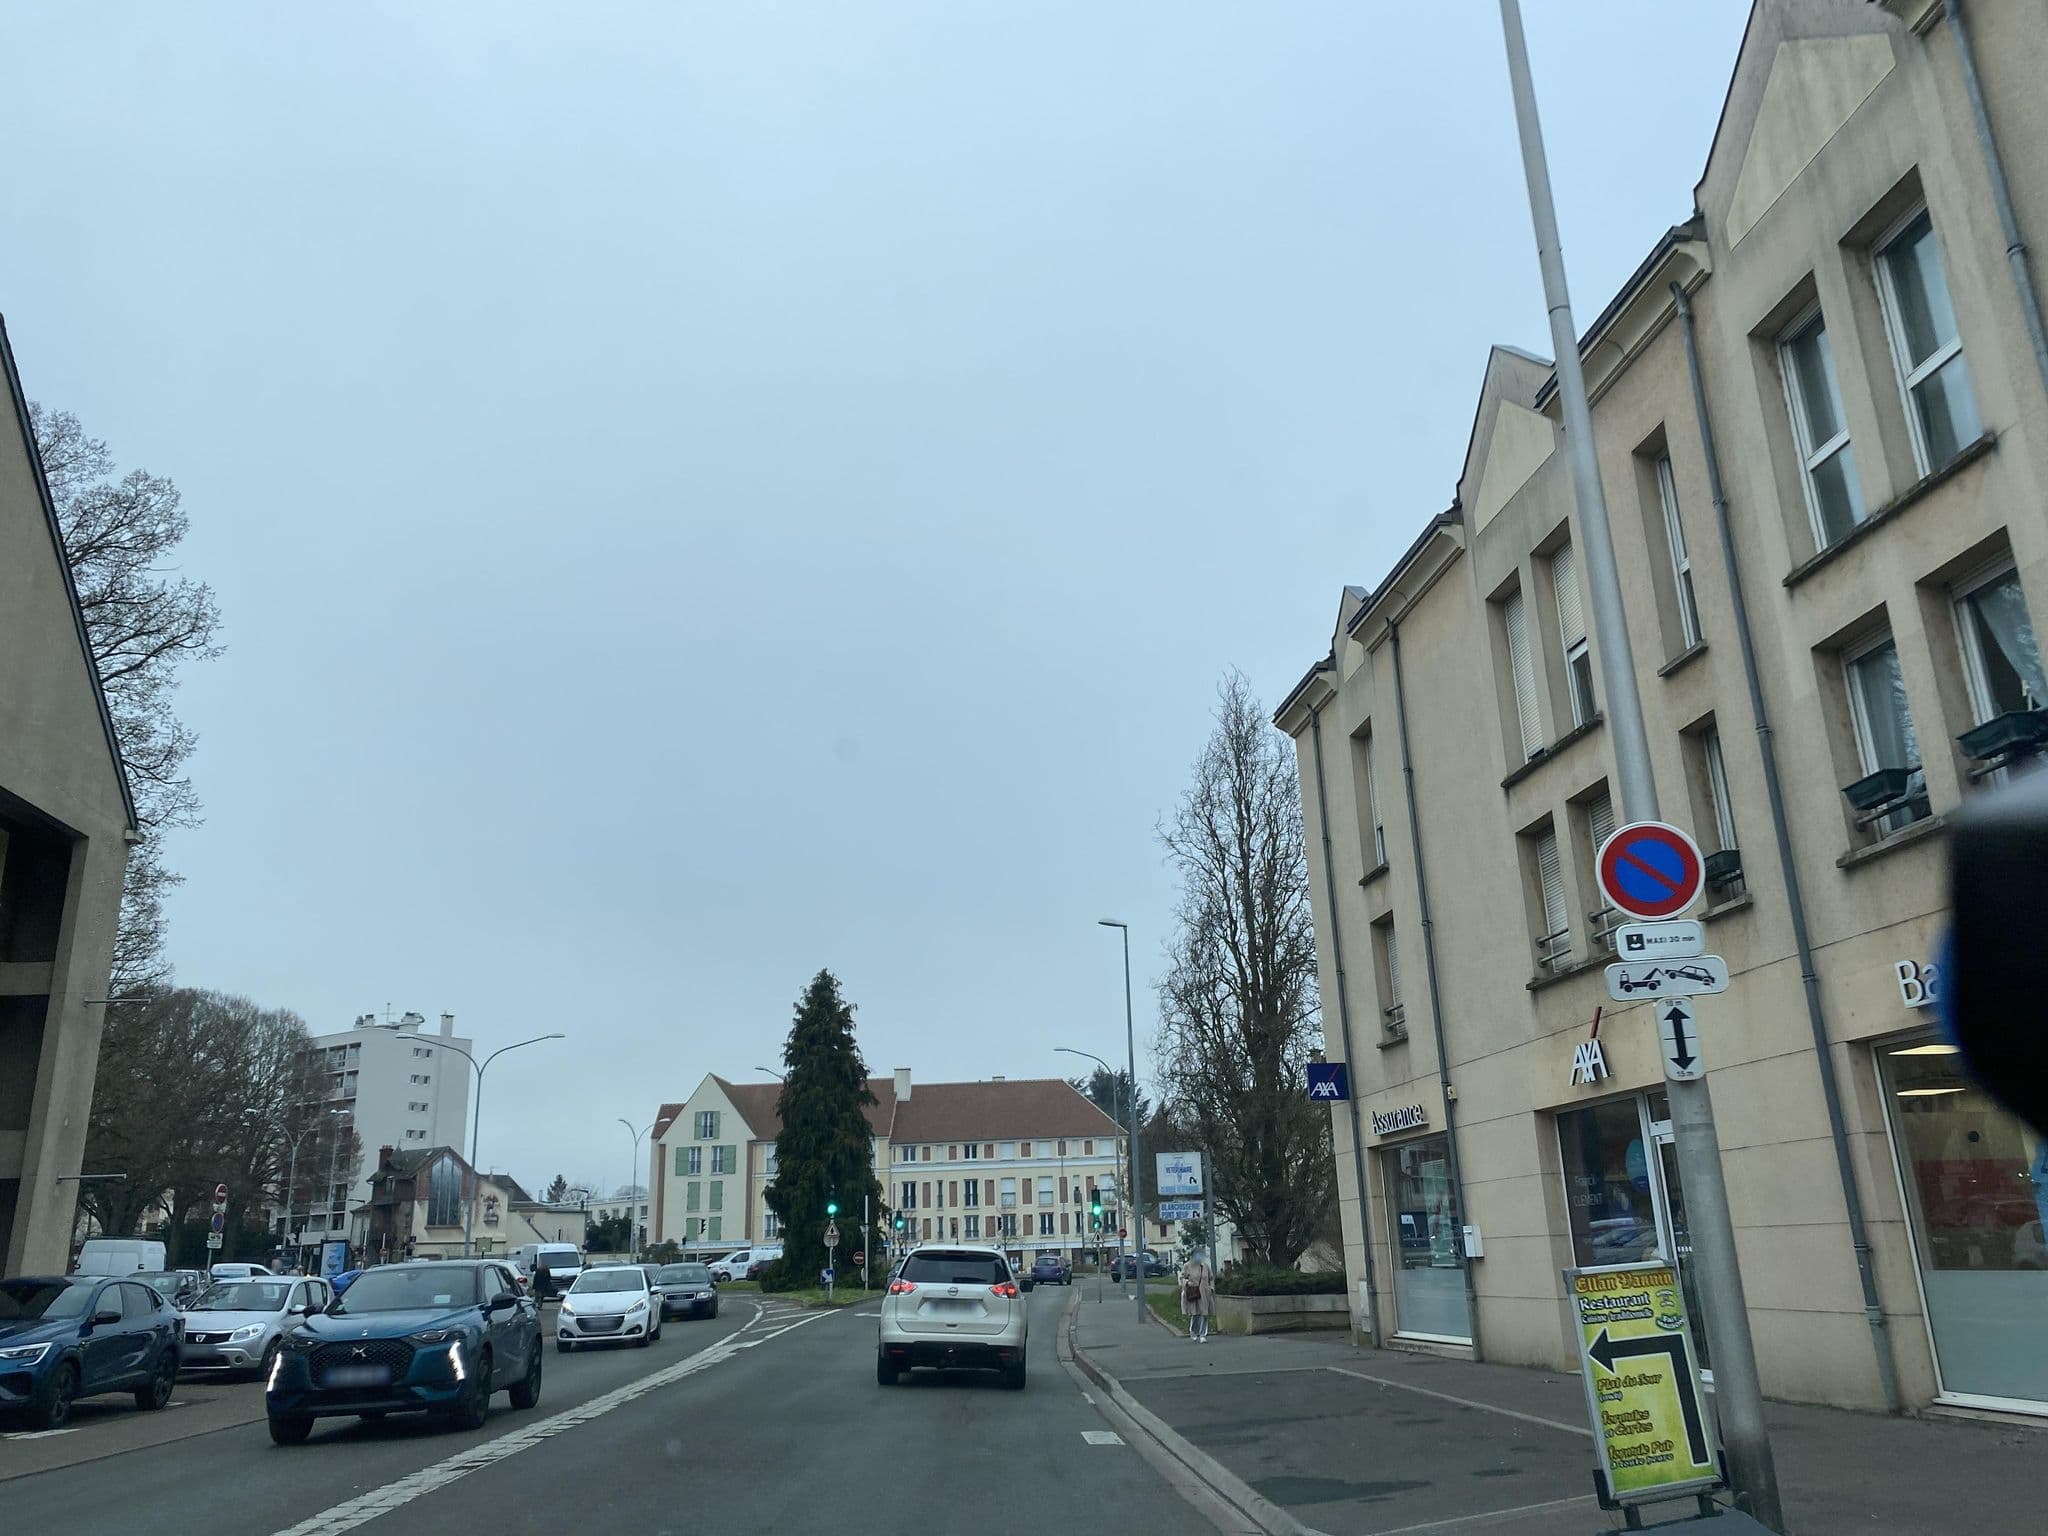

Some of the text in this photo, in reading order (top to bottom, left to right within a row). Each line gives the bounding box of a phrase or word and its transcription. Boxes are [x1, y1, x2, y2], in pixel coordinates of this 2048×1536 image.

[1570, 1039, 1612, 1086] AXA
[1310, 1081, 1339, 1097] AXA
[1371, 1104, 1424, 1135] Assurance
[1575, 1276, 1617, 1293] Ellan
[1579, 1293, 1650, 1311] Restaurant
[1597, 1377, 1622, 1391] Plat
[1622, 1375, 1638, 1388] du
